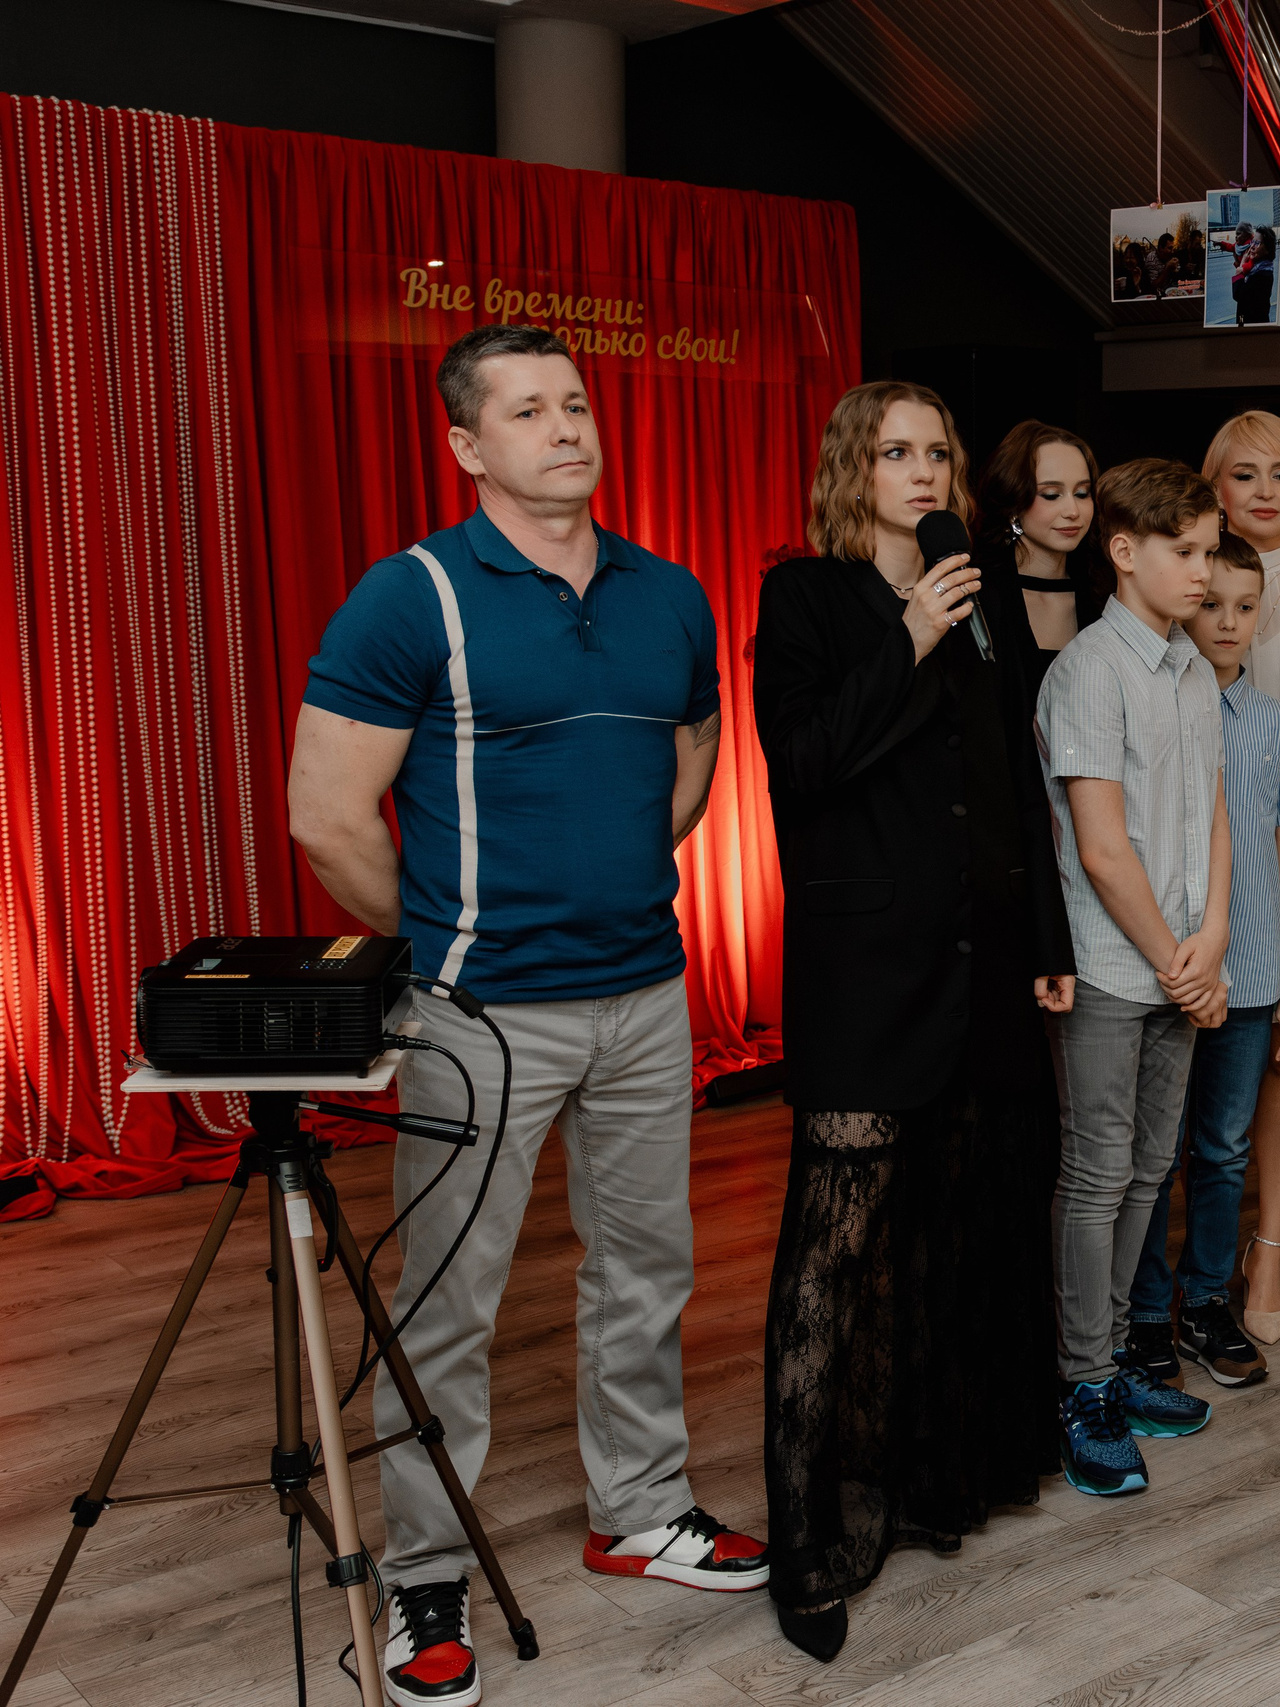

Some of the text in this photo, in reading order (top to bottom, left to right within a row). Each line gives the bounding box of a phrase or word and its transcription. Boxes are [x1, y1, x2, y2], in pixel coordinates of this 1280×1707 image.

[400, 267, 644, 325] Вне времени:
[523, 323, 740, 364] олько свои!
